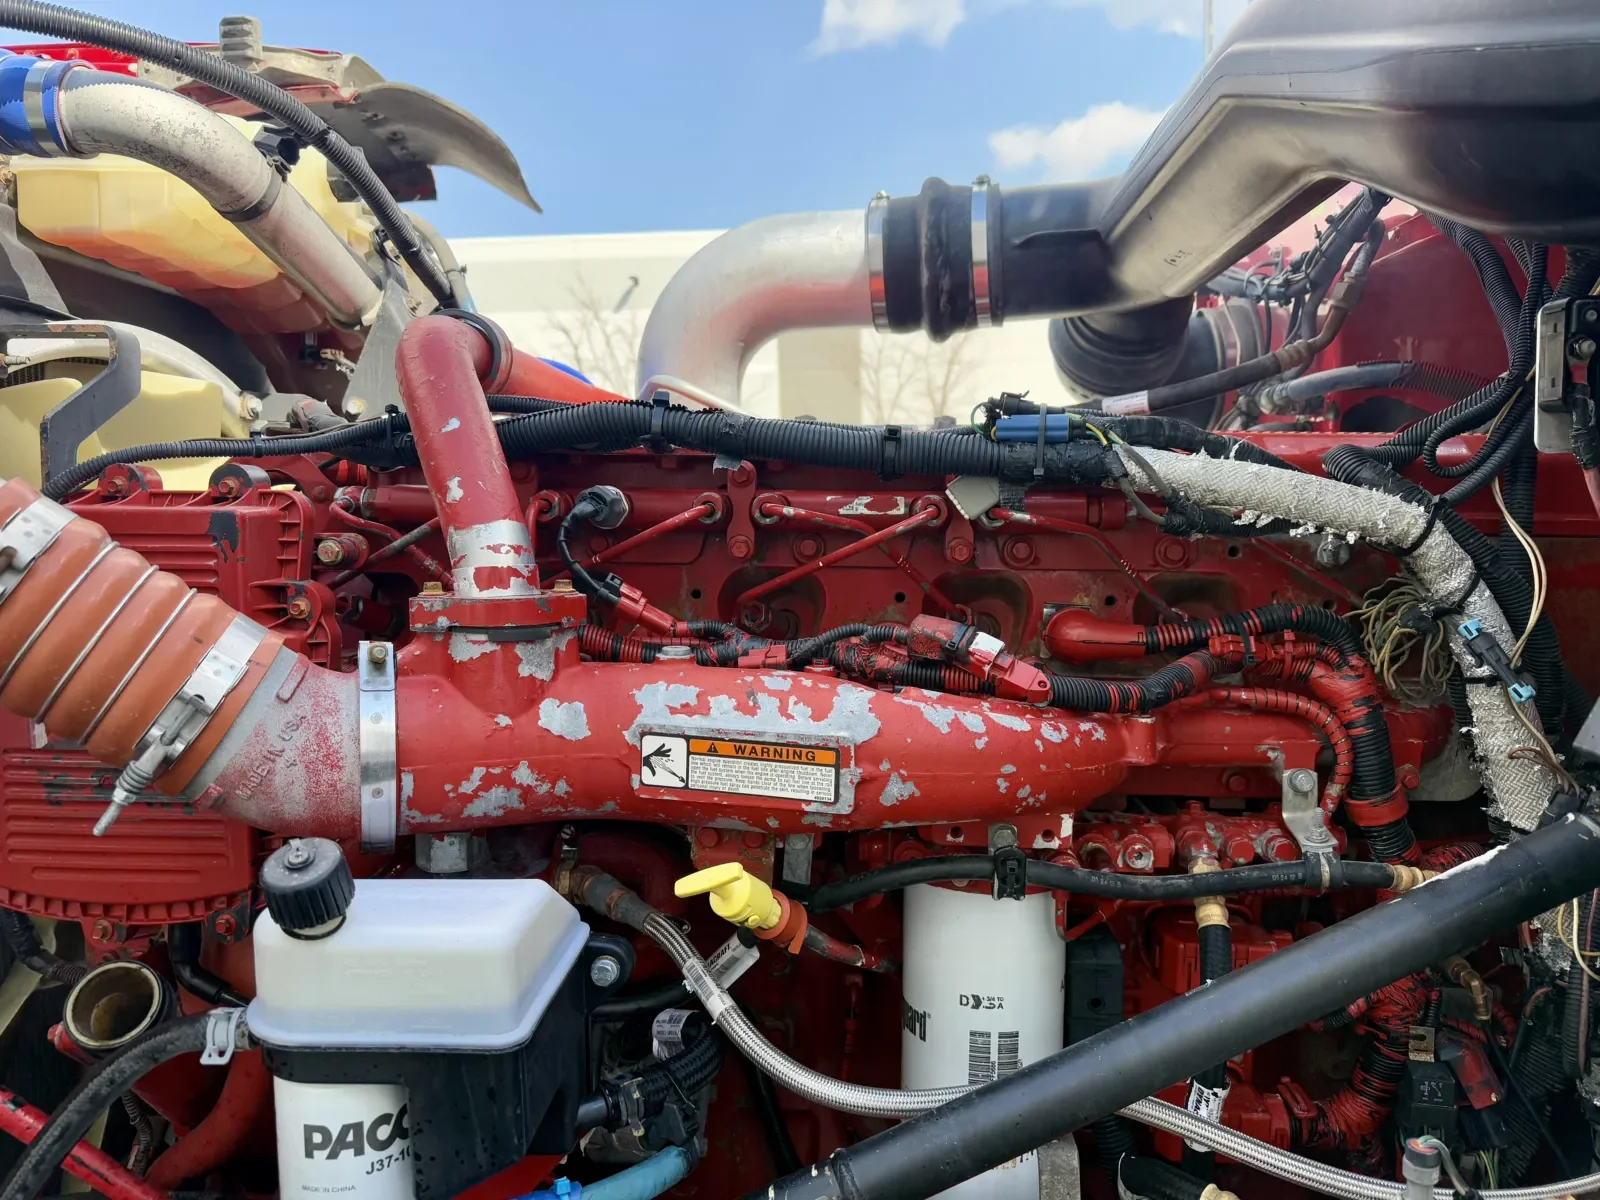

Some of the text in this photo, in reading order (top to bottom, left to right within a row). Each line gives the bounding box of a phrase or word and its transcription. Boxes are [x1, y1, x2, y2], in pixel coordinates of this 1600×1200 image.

[233, 711, 307, 801] MADE IN USA
[734, 744, 816, 761] WARNING
[302, 1184, 320, 1192] MADE
[331, 1185, 356, 1193] CHINA
